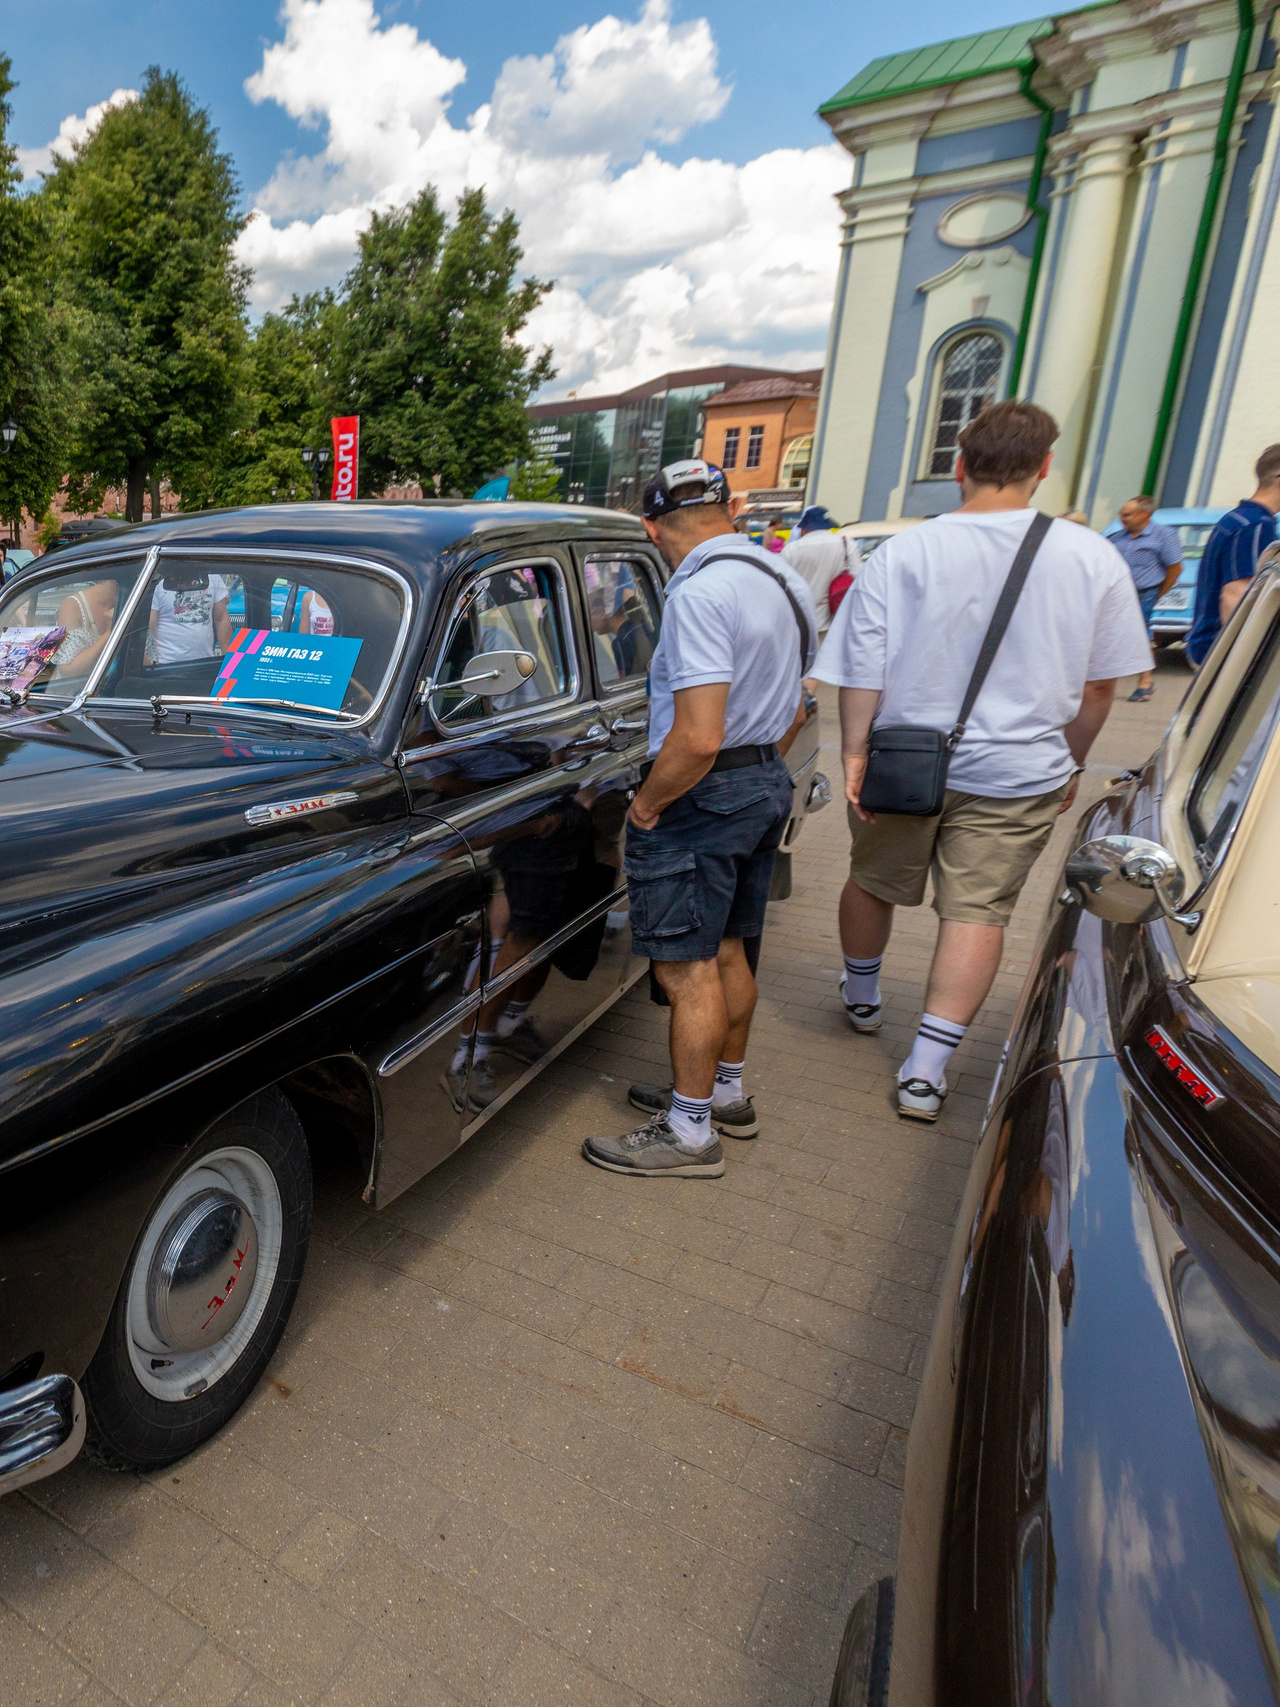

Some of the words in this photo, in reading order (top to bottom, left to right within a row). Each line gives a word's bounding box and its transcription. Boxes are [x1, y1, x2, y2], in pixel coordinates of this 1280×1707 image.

[261, 646, 287, 659] ЗИМ
[287, 648, 308, 660] ГАЗ
[309, 650, 323, 661] 12
